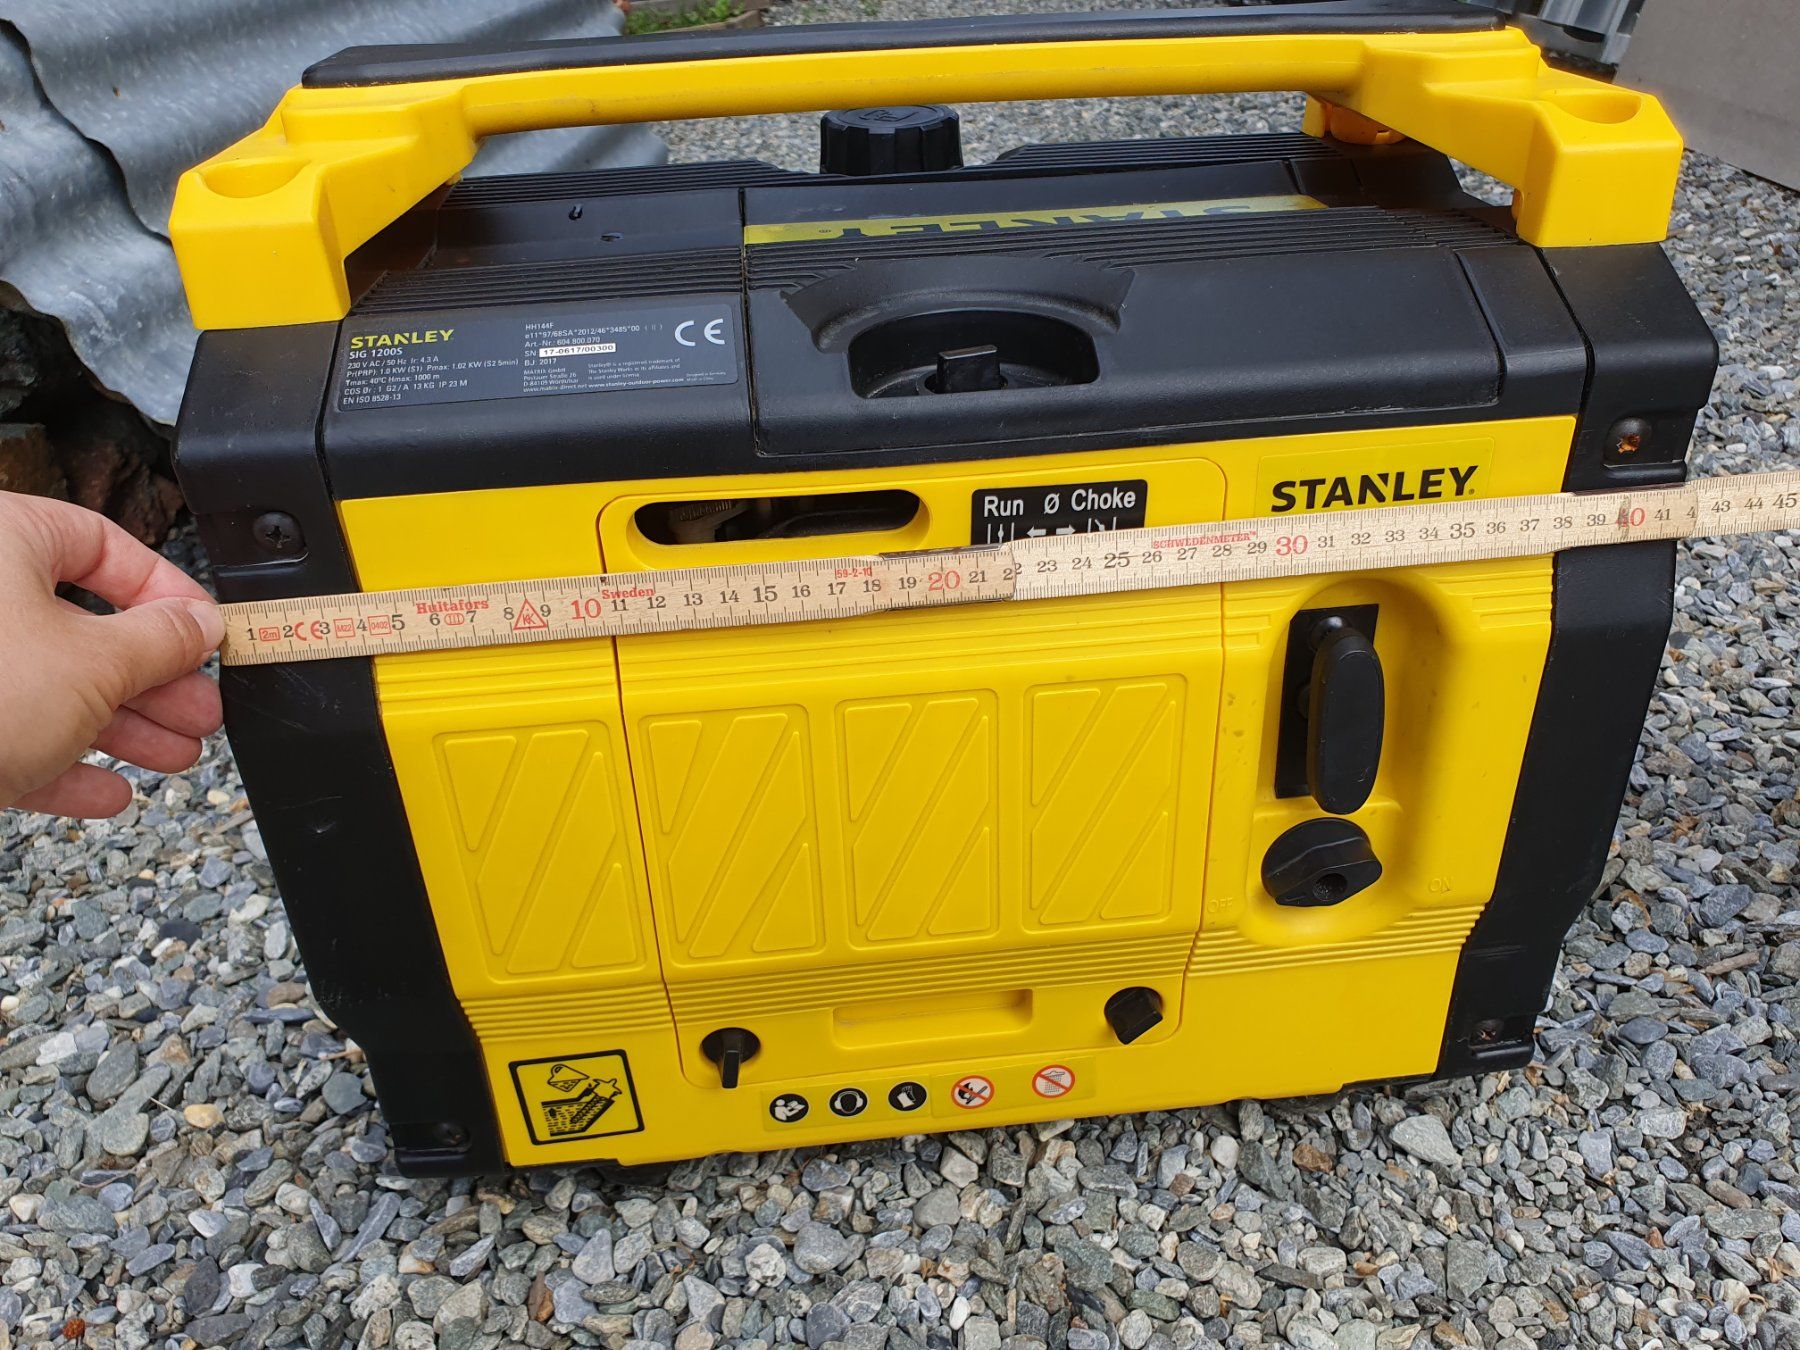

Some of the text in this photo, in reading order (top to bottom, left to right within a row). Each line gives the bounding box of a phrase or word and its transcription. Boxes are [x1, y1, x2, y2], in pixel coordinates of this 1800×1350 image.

[525, 322, 554, 330] HH144F
[350, 329, 454, 348] STANLEY
[349, 348, 403, 360] SIG 1200S
[543, 344, 614, 356] 17-0617/00300
[348, 362, 361, 370] 230
[380, 367, 390, 375] 1.0
[408, 365, 422, 374] (S1)
[426, 364, 450, 372] Pmax:
[452, 362, 467, 370] 1.02
[484, 360, 496, 368] (S2
[498, 358, 519, 368] 5min)
[414, 374, 430, 382] 1000
[344, 388, 362, 396] COS
[372, 393, 402, 402] 8528-13
[984, 495, 1024, 518] Run
[1071, 488, 1136, 511] Choke
[248, 628, 258, 641] 1
[282, 626, 294, 638] 2
[319, 622, 331, 635] 3
[356, 618, 368, 632] 4
[392, 614, 406, 631] 5
[430, 612, 440, 626] 6
[466, 610, 477, 623] 7
[503, 606, 514, 620] 8
[540, 604, 552, 618] 9
[571, 598, 602, 620] 10
[611, 598, 630, 612] 11
[646, 596, 666, 610] 12
[683, 593, 704, 607] 13
[720, 590, 740, 604] 14
[753, 586, 778, 603] 15
[792, 584, 811, 598] 16
[827, 582, 846, 596] 17
[863, 579, 882, 592] 18
[898, 576, 917, 590] 19
[928, 570, 960, 592] 20
[969, 570, 988, 584] 21
[1037, 560, 1058, 573] 23
[1072, 556, 1092, 570] 24
[1104, 552, 1131, 568] 25
[1142, 550, 1162, 564] 26
[1177, 548, 1198, 560] 27
[1212, 544, 1232, 558] 28
[1246, 541, 1268, 554] 29
[1275, 535, 1308, 556] 30
[1318, 535, 1336, 548] 31
[1351, 532, 1371, 546] 32
[1385, 530, 1406, 542] 33
[1419, 526, 1440, 540] 34
[1450, 522, 1476, 539] 35
[1486, 522, 1506, 534] 36
[1520, 518, 1540, 532] 37
[1553, 517, 1573, 530] 38
[1586, 514, 1606, 526] 39
[1654, 508, 1671, 521] 41
[1711, 500, 1731, 513] 43
[1744, 497, 1764, 510] 44
[1773, 492, 1798, 509] 45
[416, 588, 656, 614] Hultafors Sweden
[1428, 876, 1454, 894] ON
[1207, 897, 1234, 914] OFF
